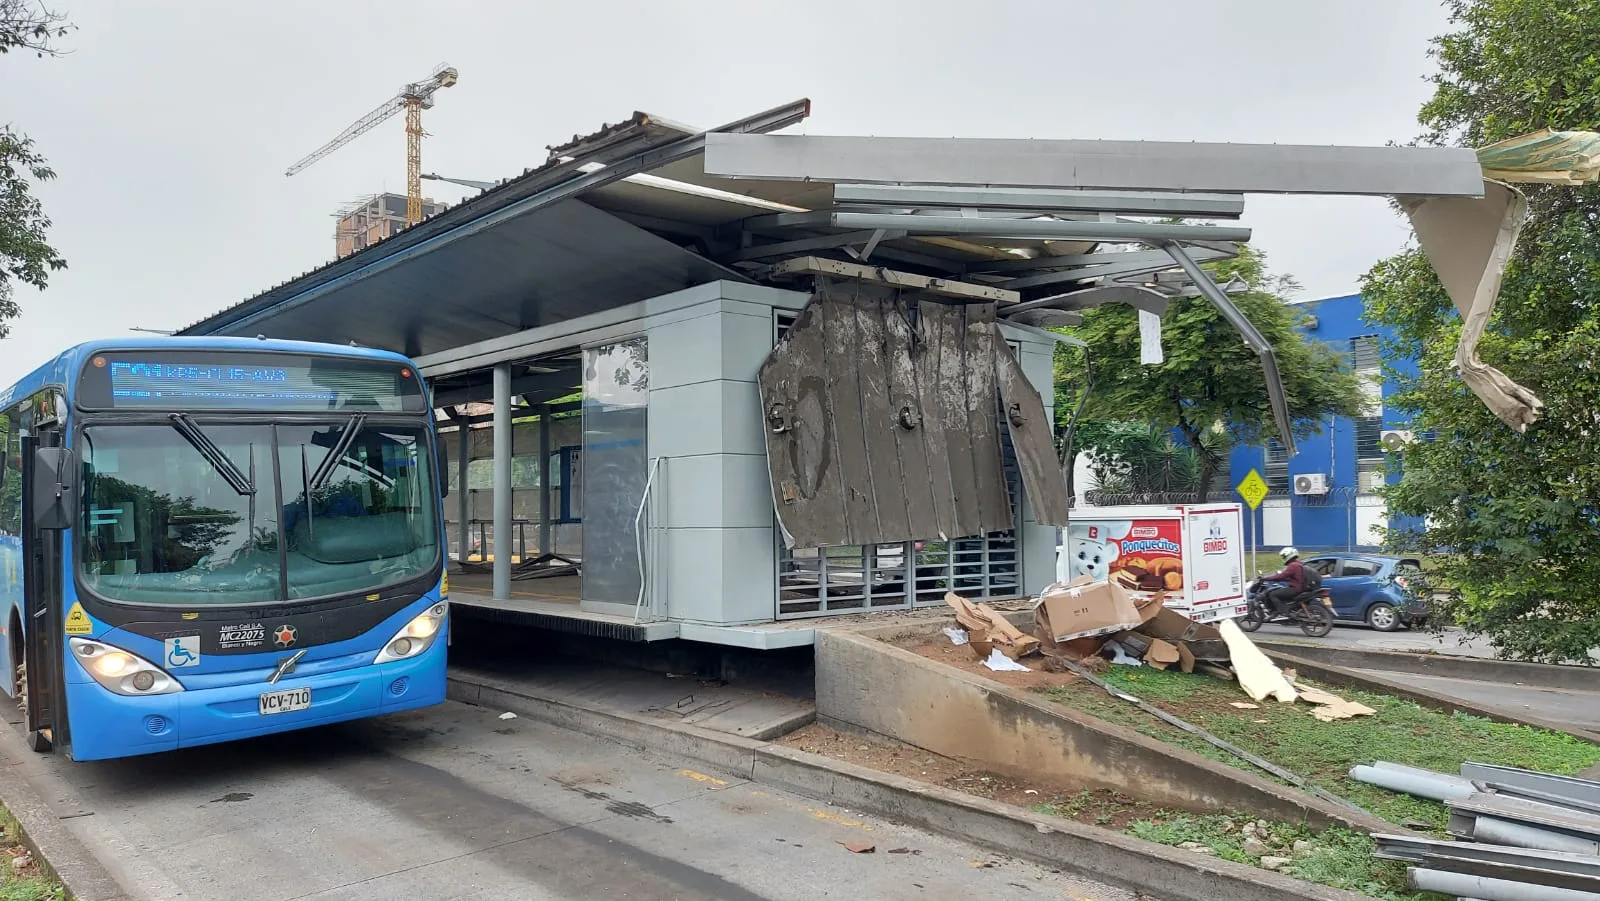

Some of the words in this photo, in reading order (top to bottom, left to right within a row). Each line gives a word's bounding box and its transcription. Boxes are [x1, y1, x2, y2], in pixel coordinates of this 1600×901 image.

[1121, 538, 1180, 555] Ponquecitos
[1203, 540, 1227, 552] BIMBO
[220, 630, 265, 641] MC22075
[262, 691, 309, 710] VCV-710
